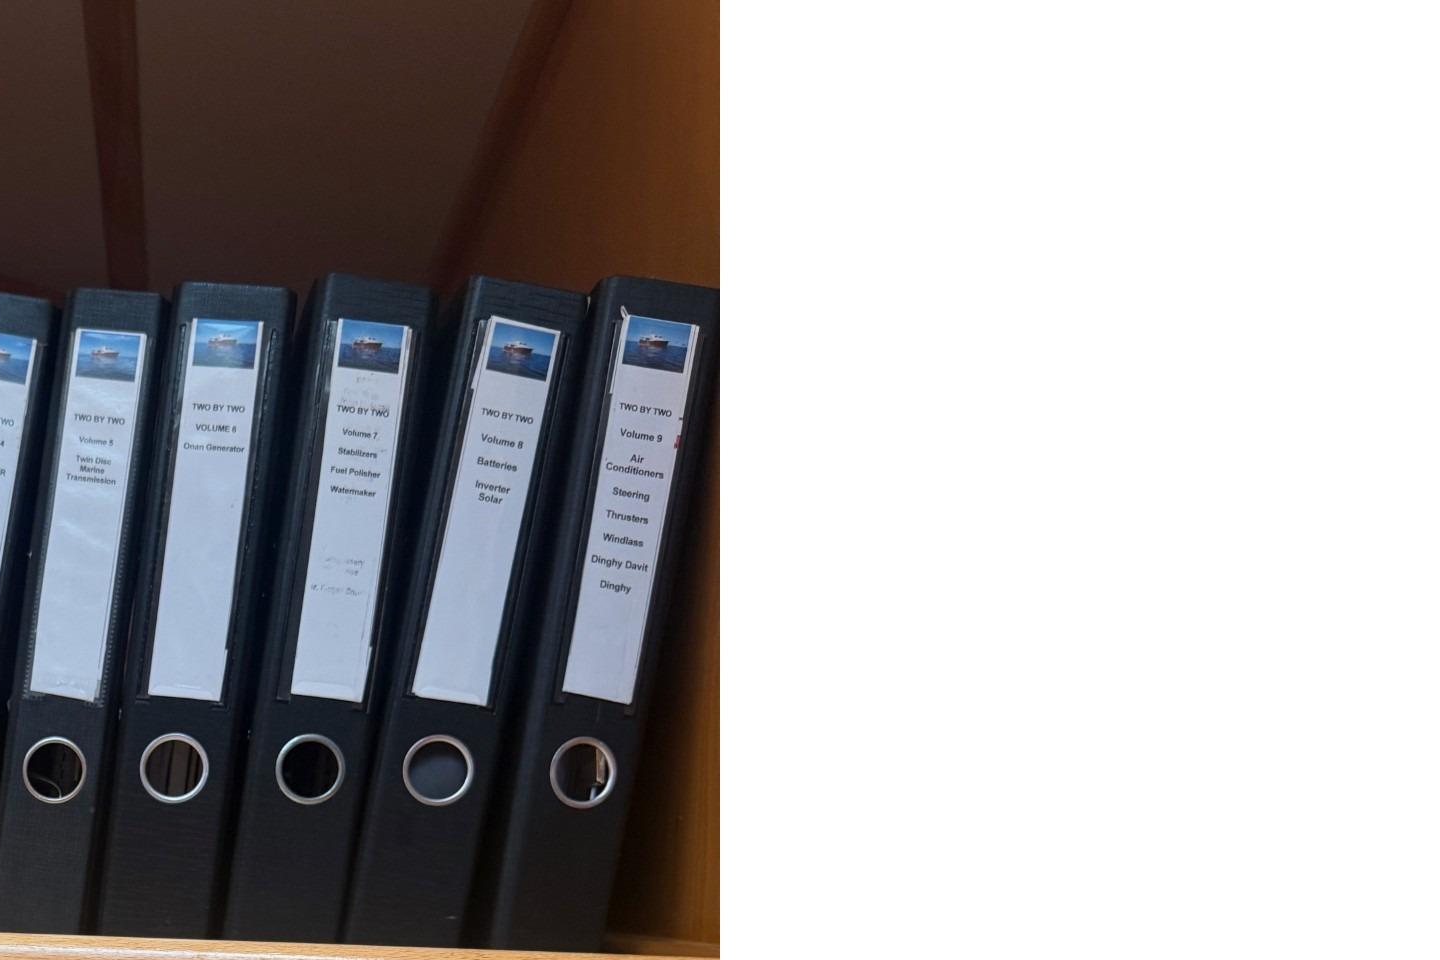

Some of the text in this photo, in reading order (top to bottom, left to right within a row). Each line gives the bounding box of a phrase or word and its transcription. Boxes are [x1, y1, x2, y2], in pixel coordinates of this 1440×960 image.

[192, 403, 246, 413] TWO BY TWO
[337, 404, 390, 418] TWO BY TWO
[619, 402, 672, 418] TWO BY TWO
[74, 413, 126, 426] TWO BY TWO
[481, 407, 534, 425] TWO BY TWO
[195, 423, 231, 433] VOLUME
[342, 428, 372, 439] Volume
[79, 436, 107, 446] Volume
[481, 433, 524, 449] Volume 8
[620, 428, 663, 443] Volume 9
[206, 443, 245, 453] Generator
[337, 447, 378, 459] Stabilizers
[76, 454, 93, 464] Twin
[476, 456, 518, 472] Batteries
[630, 453, 645, 464] Air
[80, 465, 105, 475] Marine
[330, 466, 381, 479] Fuel Polisher
[606, 462, 664, 479] Conditioners
[66, 473, 116, 486] Transmission
[330, 485, 377, 498] Watermaker
[475, 479, 511, 494] Inverter
[478, 492, 503, 505] Solar
[612, 486, 650, 502] Steering
[606, 509, 649, 525] Thrusters
[602, 532, 644, 547] Windlass
[591, 554, 649, 572] Dinghy Davit
[599, 579, 632, 595] Dinghy
